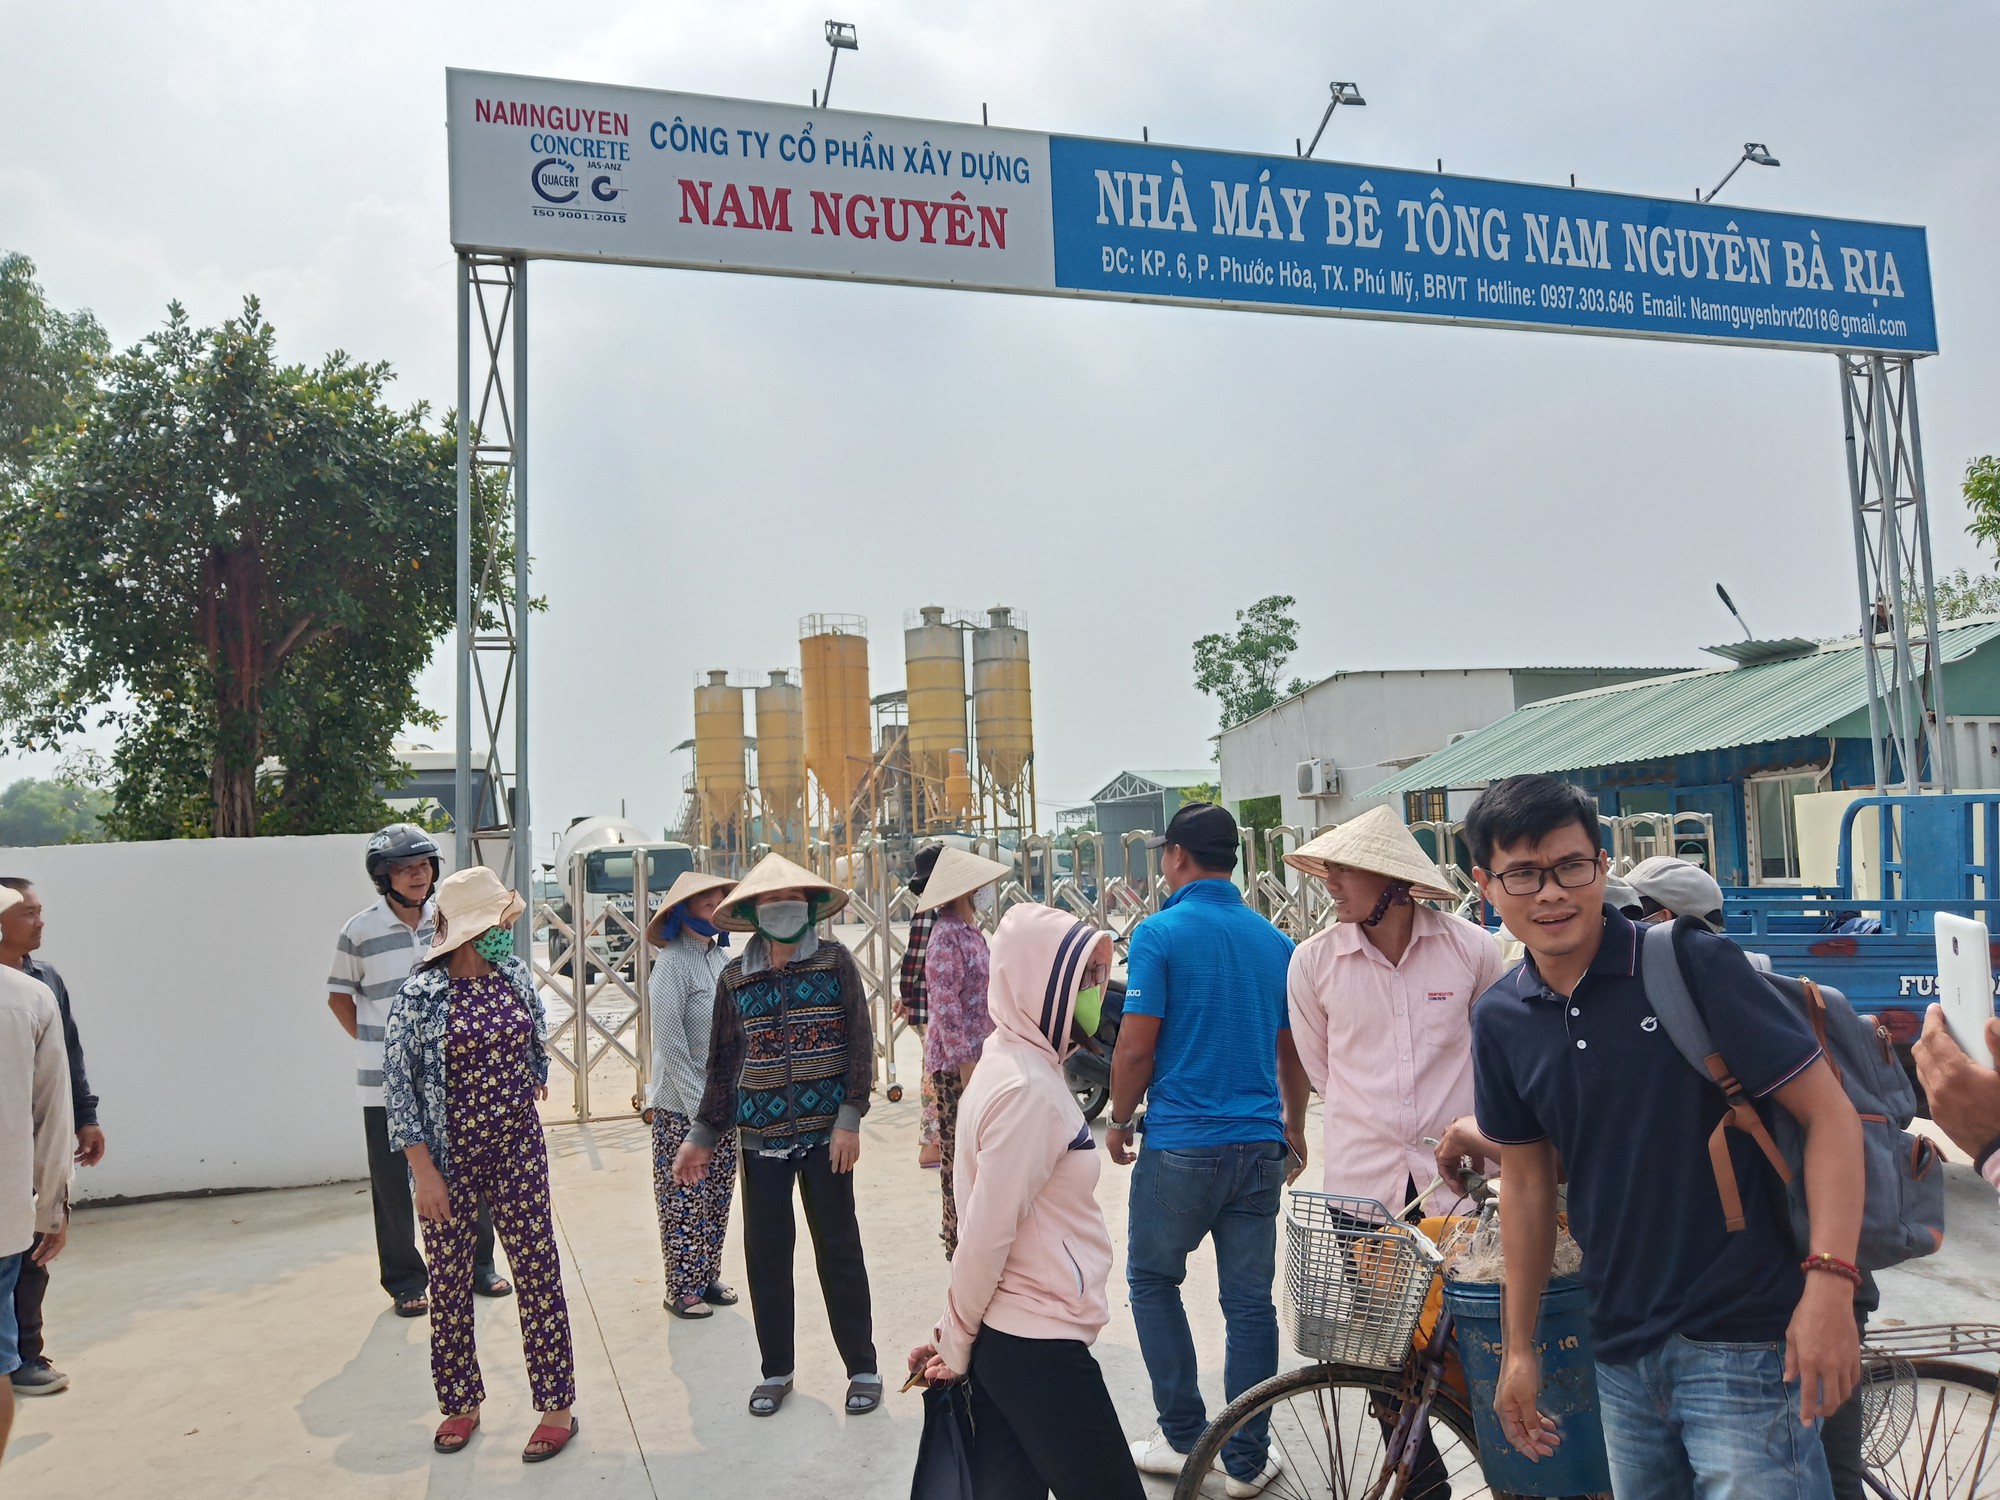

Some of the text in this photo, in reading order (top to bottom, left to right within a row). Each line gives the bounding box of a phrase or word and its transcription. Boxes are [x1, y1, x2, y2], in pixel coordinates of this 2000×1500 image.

[475, 98, 629, 137] NAMNGUYEN
[530, 133, 630, 161] CONCRETE
[649, 116, 1030, 185] CÔNG TY CỔ PHẦN XÂY DỰNG
[541, 173, 579, 188] QUACERT
[532, 208, 626, 223] ISO 9001:2015
[677, 178, 1008, 249] NAM NGUYÊN
[1094, 159, 1905, 308] NHÀ MÁY BÊ TÔNG NAM NGUYÊN BÀ RỊA
[1102, 245, 1907, 338] ĐC: KP. 6, P. Phước Hòa, TX. Phú Mỹ, BRVT Hotline: 0937.303.646 Email: Namnguyenbrvt2018@gmail.com
